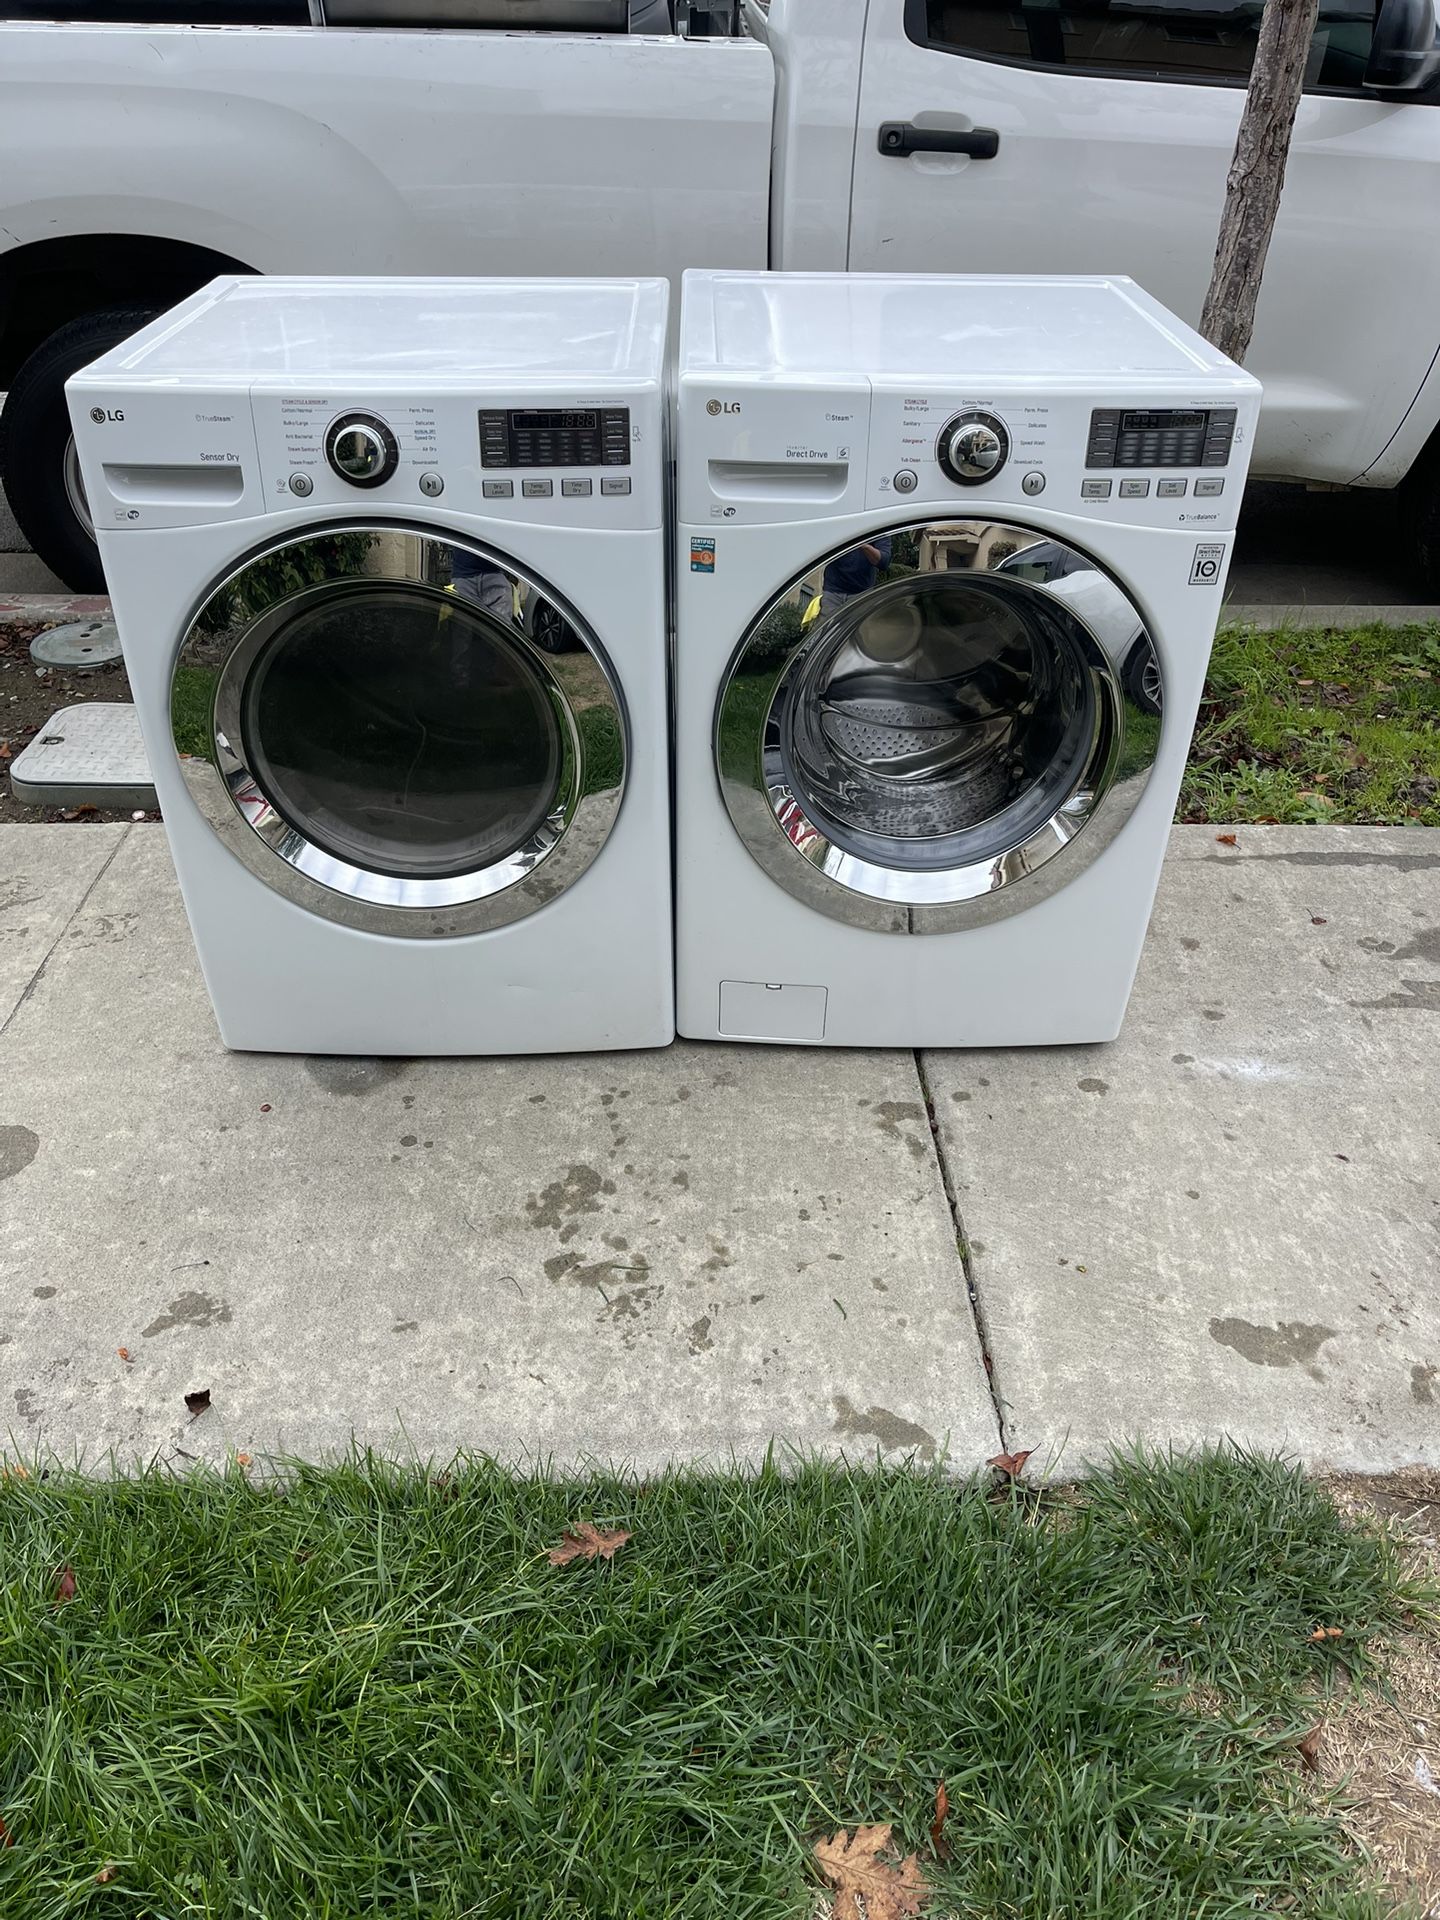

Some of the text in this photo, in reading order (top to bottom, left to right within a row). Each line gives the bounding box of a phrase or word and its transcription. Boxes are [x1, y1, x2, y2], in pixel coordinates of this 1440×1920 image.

[723, 402, 741, 413] LG
[107, 410, 125, 421] LG
[200, 452, 240, 463] Sensor Dry
[786, 449, 829, 458] Direct Drive
[1195, 560, 1217, 577] 10
